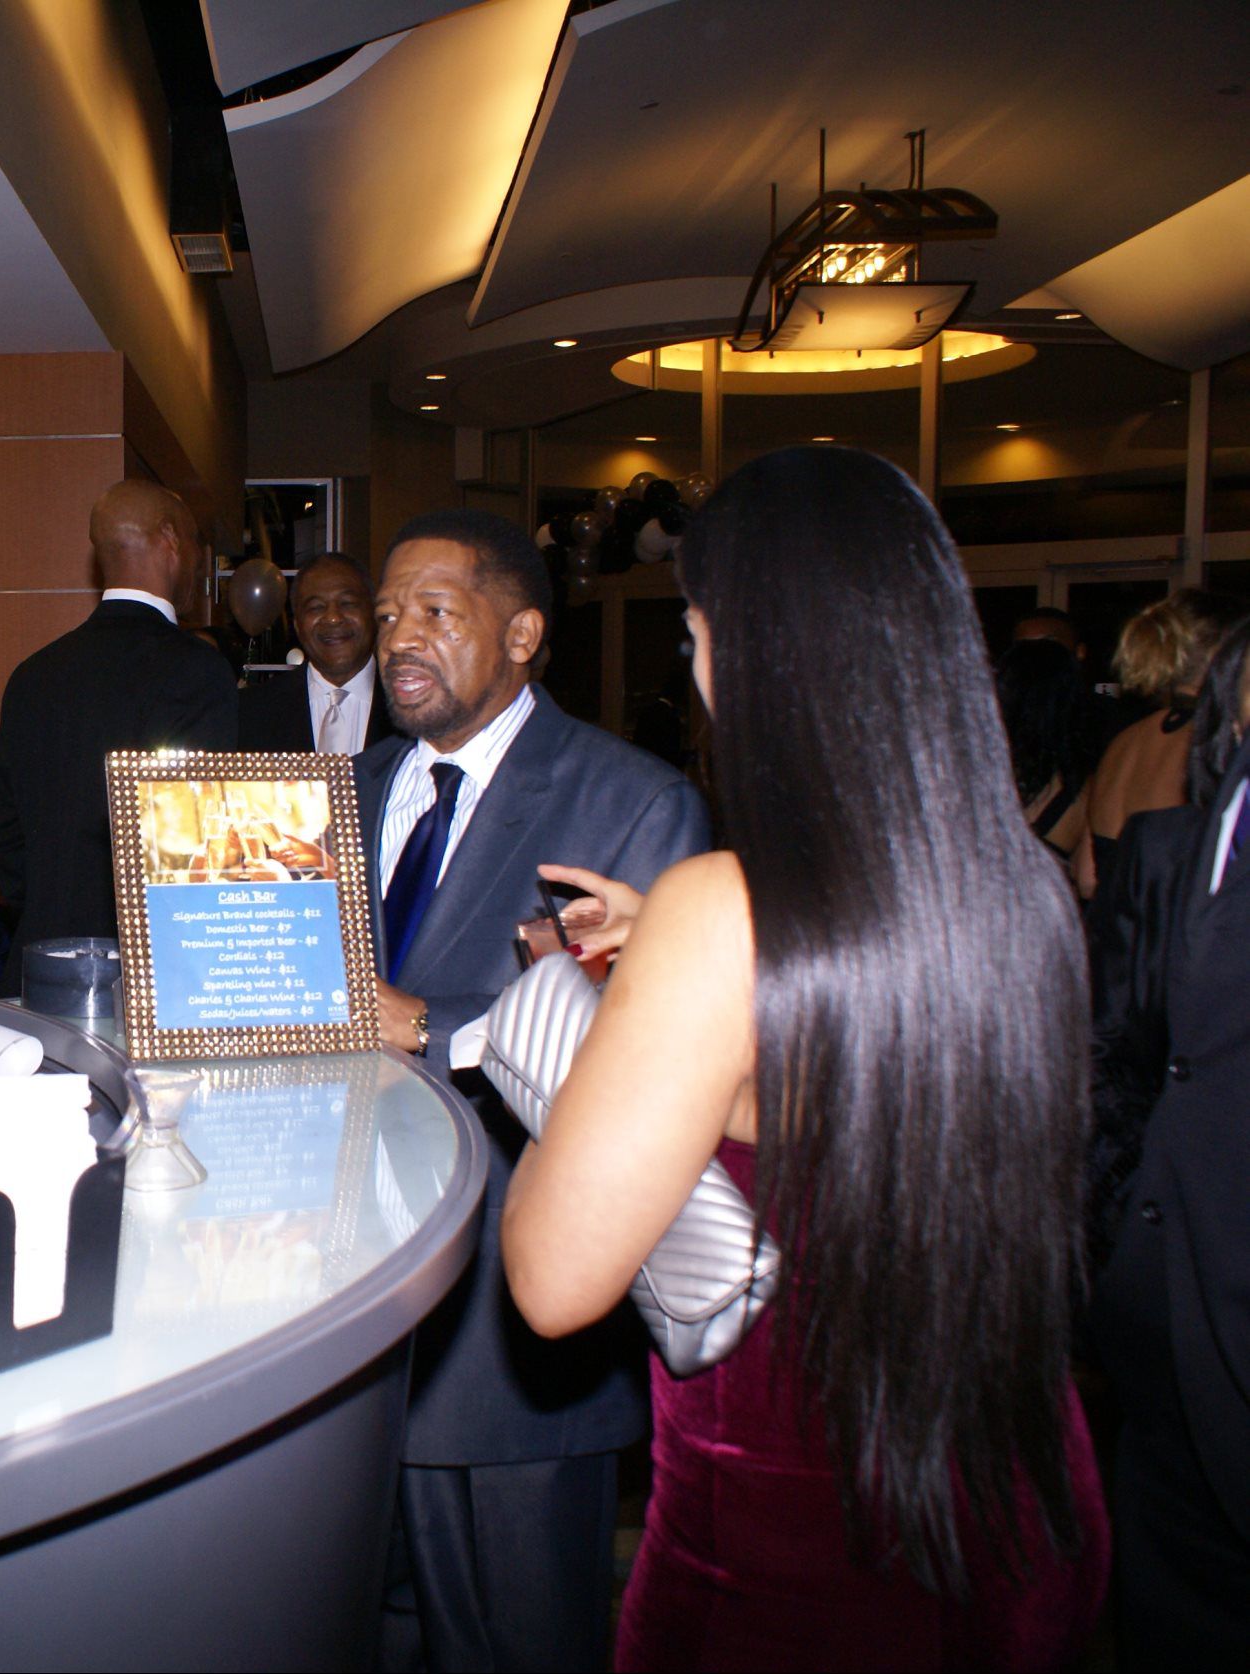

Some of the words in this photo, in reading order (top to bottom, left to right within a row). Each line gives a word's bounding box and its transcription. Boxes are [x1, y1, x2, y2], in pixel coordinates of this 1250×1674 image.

[219, 891, 251, 904] Cash
[251, 891, 276, 903] Bar
[173, 912, 221, 923] Signature
[222, 910, 253, 919] Brand
[255, 909, 295, 918] cocktails
[303, 908, 321, 919] $11
[206, 924, 247, 934] Domestic
[249, 924, 268, 932] Beer
[181, 939, 225, 948] Premium
[227, 939, 234, 949] &
[236, 937, 275, 948] Imported
[276, 937, 296, 946] Beer
[219, 952, 257, 961] Cordials
[265, 951, 284, 962] $12
[209, 967, 244, 976] Canvas
[246, 966, 270, 974] Wine
[278, 964, 296, 975] $11
[203, 980, 252, 993] Sparkling
[254, 979, 276, 988] wine
[188, 995, 223, 1005] Charles
[225, 995, 232, 1006] &
[234, 994, 269, 1003] Charles
[268, 992, 295, 1001] Wine
[303, 991, 322, 1002] $12
[199, 1007, 292, 1020] Sodas/juices/waters
